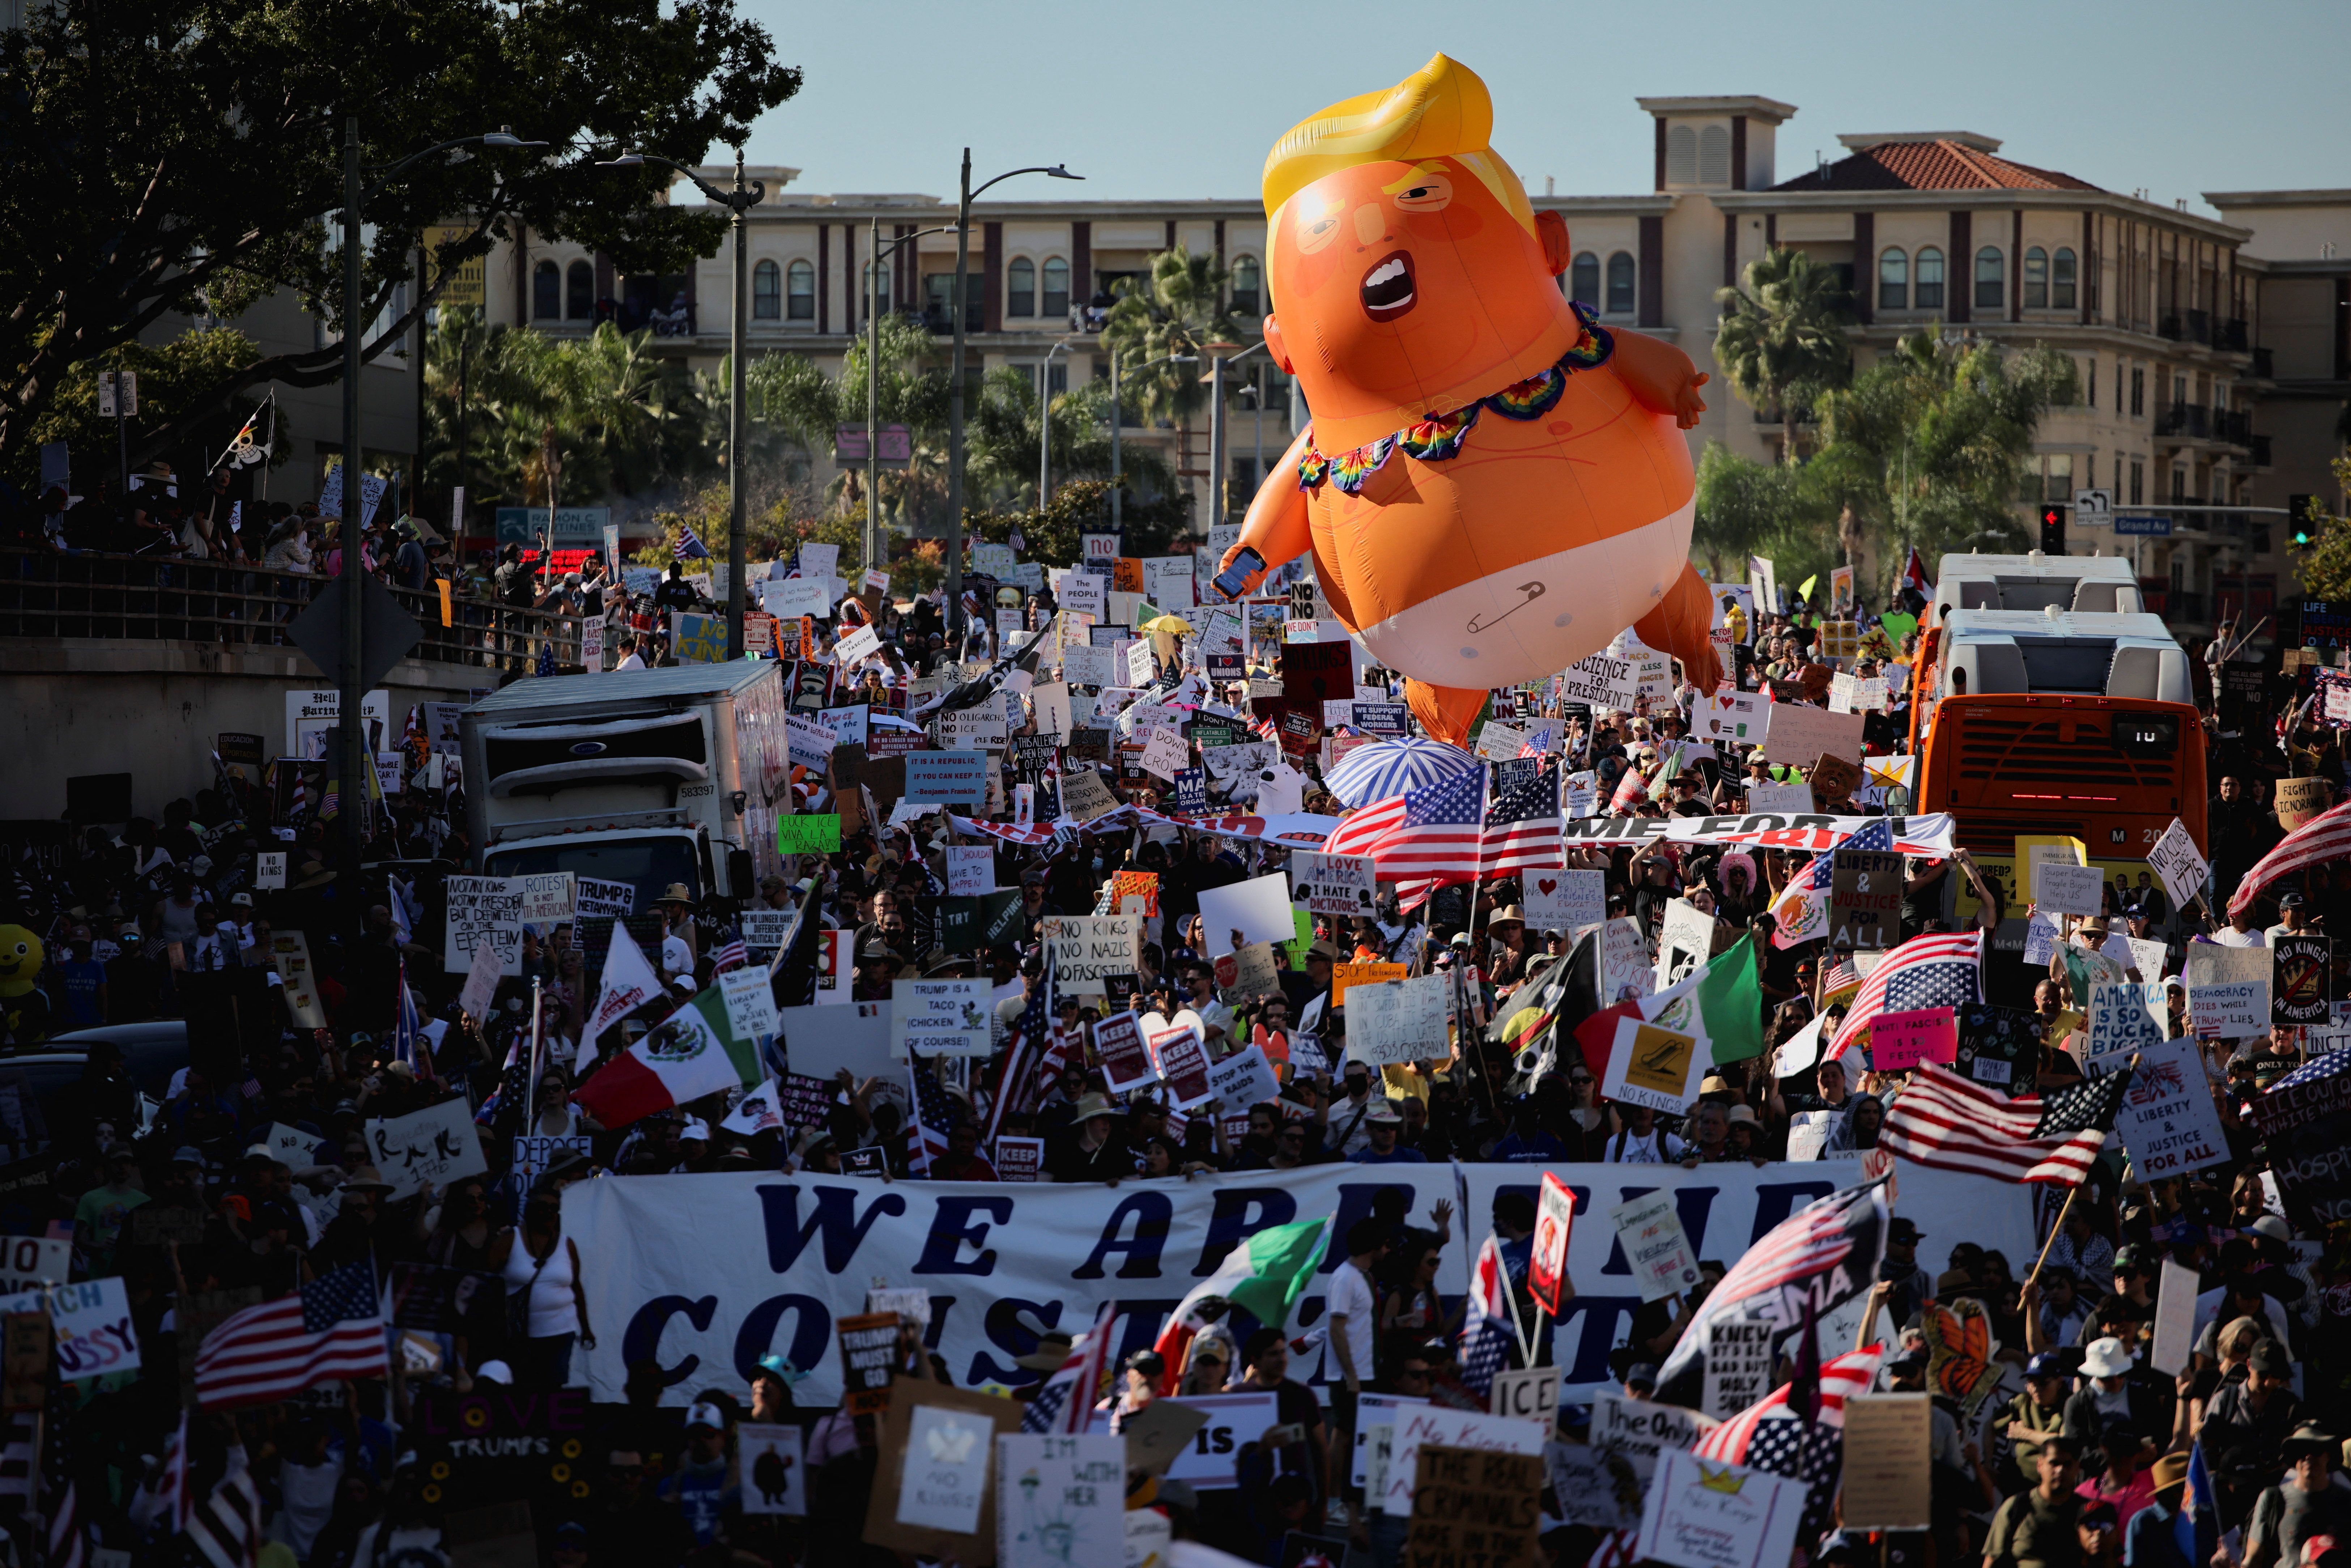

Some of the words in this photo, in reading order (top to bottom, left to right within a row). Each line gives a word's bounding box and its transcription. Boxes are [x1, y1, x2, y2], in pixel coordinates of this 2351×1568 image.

[2119, 520, 2151, 530] Grand
[2153, 522, 2167, 530] Av
[978, 550, 1009, 560] DUMP
[1292, 585, 1313, 600] NO
[1292, 603, 1314, 619] NO
[2304, 602, 2326, 613] LIFE
[698, 619, 726, 639] NO
[745, 620, 751, 630] NO
[753, 620, 769, 629] STOPPING
[1287, 622, 1297, 632] WE
[1298, 621, 1316, 631] DON'T
[839, 639, 852, 650] FUCK
[1211, 667, 1240, 675] UNIONS
[1572, 656, 1630, 680] SCIENCE
[1590, 676, 1609, 688] FOR
[1865, 680, 1885, 691] BALLS
[313, 693, 336, 703] Hell
[1568, 682, 1633, 708] PRESIDENT
[1830, 692, 1850, 710] DICK
[2246, 692, 2261, 702] NO
[822, 712, 854, 726] Power
[941, 713, 956, 721] NO
[1501, 770, 1535, 784] EPILEPSY
[681, 785, 714, 798] 583397
[2283, 783, 2311, 796] FIGHT
[2279, 796, 2325, 813] IGNORANCE
[782, 815, 809, 827] FUCK
[818, 816, 836, 827] ICE
[2293, 812, 2308, 824] NOT
[782, 829, 803, 839] VIVA
[811, 830, 826, 839] LA
[2113, 829, 2124, 843] M
[2150, 848, 2165, 873] NO
[2165, 820, 2188, 862] KINGS
[267, 856, 275, 864] NO
[1313, 855, 1319, 867] I
[1327, 857, 1362, 870] LOVE
[1836, 854, 1902, 873] LIBERTY
[2172, 849, 2191, 875] SINCE
[261, 866, 281, 876] KINGS
[1305, 867, 1366, 885] AMERICA
[2044, 868, 2068, 878] Super
[2072, 869, 2096, 879] Callous
[1857, 872, 1870, 892] &
[2046, 878, 2066, 889] Fragile
[2070, 879, 2091, 891] Bigot
[2173, 857, 2205, 902] 1776
[579, 881, 621, 900] TRUMP
[623, 888, 632, 903] &
[1315, 887, 1318, 896] I
[1323, 887, 1351, 897] HATE
[1310, 898, 1359, 913] DICTATORS
[1833, 892, 1897, 909] JUSTICE
[450, 909, 469, 922] BUT
[948, 912, 969, 926] TRY
[1849, 910, 1878, 925] FOR
[477, 921, 493, 930] THE
[1061, 922, 1080, 938] NO
[1093, 921, 1127, 935] KINGS
[456, 930, 519, 951] EPSTEIN
[1832, 926, 1886, 946] ALL
[1061, 942, 1081, 959] NO
[1092, 942, 1131, 959] NAZIS
[2275, 947, 2292, 964] NO
[2295, 942, 2327, 964] KINGS
[914, 985, 947, 994] TRUMP
[953, 984, 961, 993] IS
[2093, 983, 2165, 1007] AMERICA
[2190, 987, 2254, 998] DEMOCRACY
[929, 1001, 955, 1010] TACO
[2194, 1002, 2216, 1010] DIES
[908, 1017, 953, 1029] (CHICKEN
[2095, 1010, 2110, 1023] IS
[2117, 1009, 2140, 1023] SO
[2194, 1015, 2226, 1025] TRUMP
[2230, 1014, 2253, 1024] LIES
[1875, 1023, 1899, 1031] ANTI
[1905, 1016, 1949, 1029] FASCISM
[1100, 1021, 1134, 1042] KEEP
[2093, 1024, 2155, 1038] MUCH
[924, 1037, 970, 1048] COURSE!)
[1102, 1036, 1138, 1053] FAMILIES
[1893, 1038, 1903, 1047] IS
[1911, 1037, 1925, 1045] SO
[1889, 1049, 1934, 1061] FETCH!
[1212, 1068, 1236, 1086] STOP
[1237, 1058, 1258, 1073] THE
[2257, 1062, 2283, 1070] ONLY
[787, 1077, 823, 1089] MAKE
[1224, 1075, 1254, 1095] RAIDS
[783, 1089, 830, 1103] ORWELL
[1618, 1085, 1636, 1100] NO
[1638, 1090, 1682, 1113] KINGS
[2136, 1099, 2190, 1122] LIBERTY
[2164, 1122, 2174, 1131] &
[2147, 1131, 2201, 1154] JUSTICE
[1000, 1148, 1037, 1162] KEEP
[756, 1184, 1014, 1275] WE
[1634, 1236, 1680, 1259] WELCOME
[843, 1325, 898, 1349] TRUMP
[1711, 1325, 1770, 1343] KNEW
[850, 1350, 896, 1369] MUST
[864, 1369, 889, 1388] GO
[1719, 1379, 1759, 1392] HOLY
[1501, 1379, 1554, 1416] ICE
[1606, 1400, 1647, 1435] The
[1651, 1412, 1694, 1450] Only
[449, 1436, 549, 1457] TRUMPS
[1196, 1427, 1233, 1454] IS
[1064, 1487, 1097, 1506] HER
